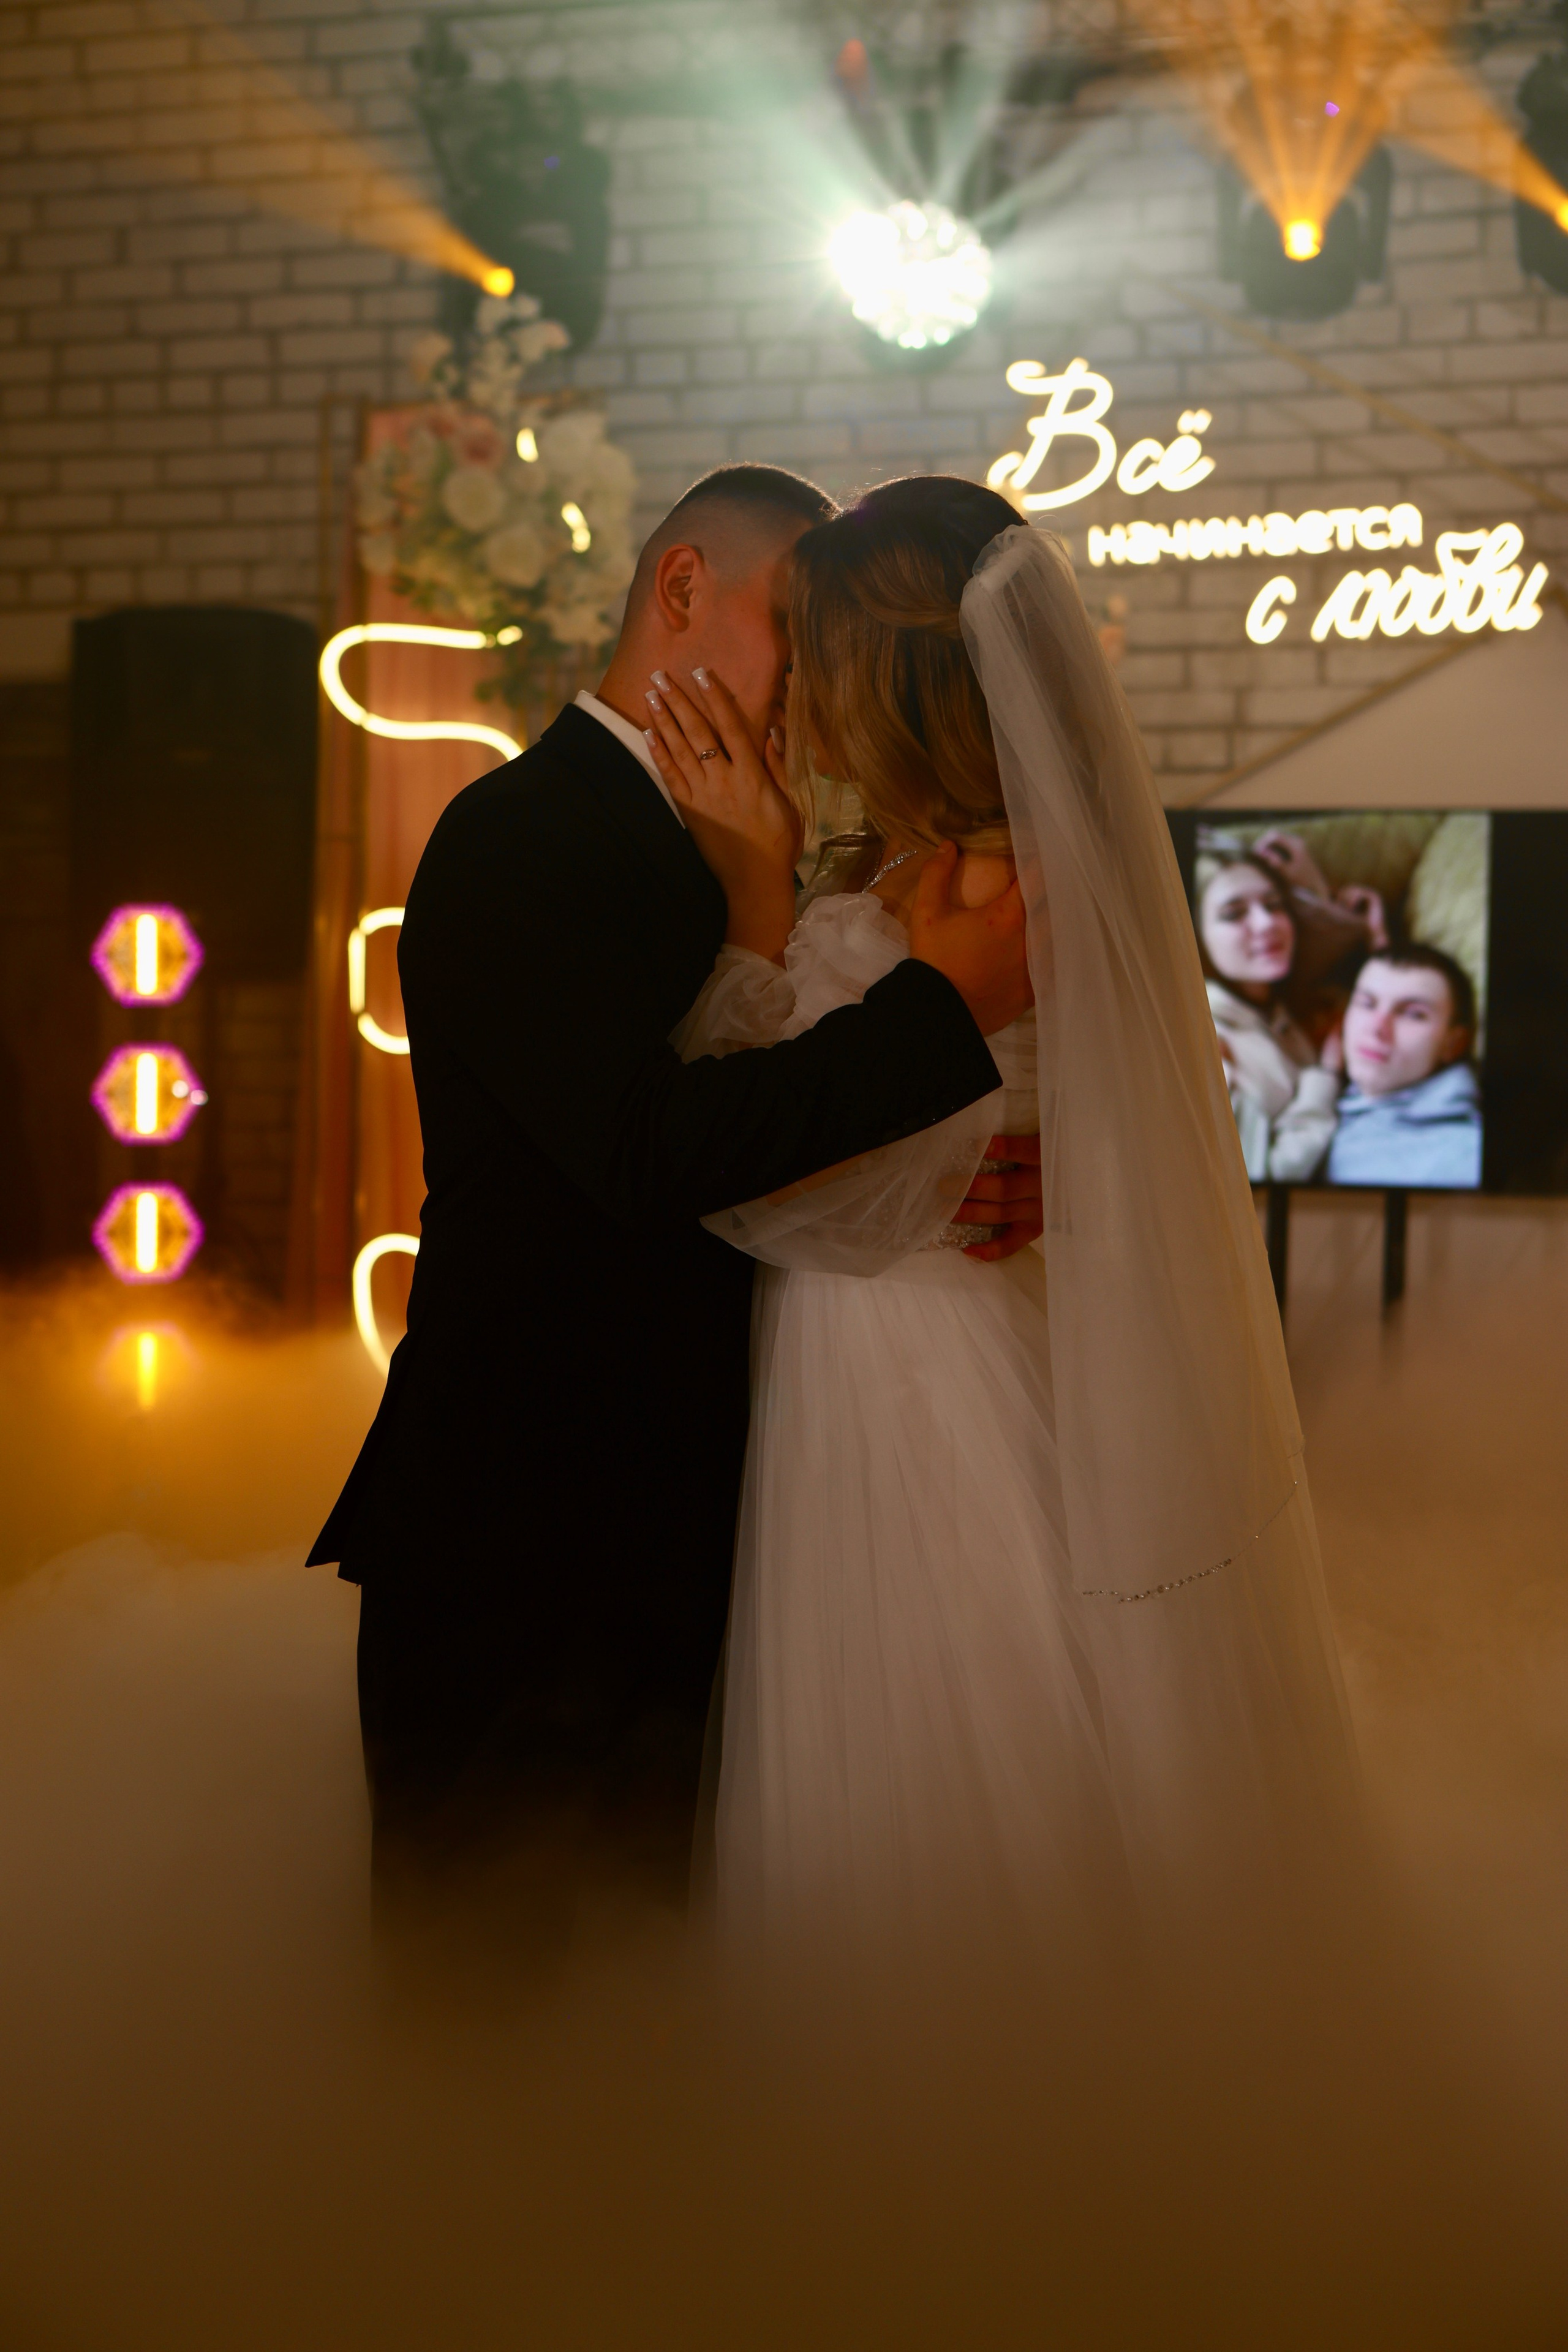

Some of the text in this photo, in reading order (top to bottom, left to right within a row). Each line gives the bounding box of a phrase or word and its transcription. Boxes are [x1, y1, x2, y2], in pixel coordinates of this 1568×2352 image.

[987, 358, 1215, 511] Всё
[1088, 503, 1422, 565] начинается
[1311, 523, 1548, 641] любви
